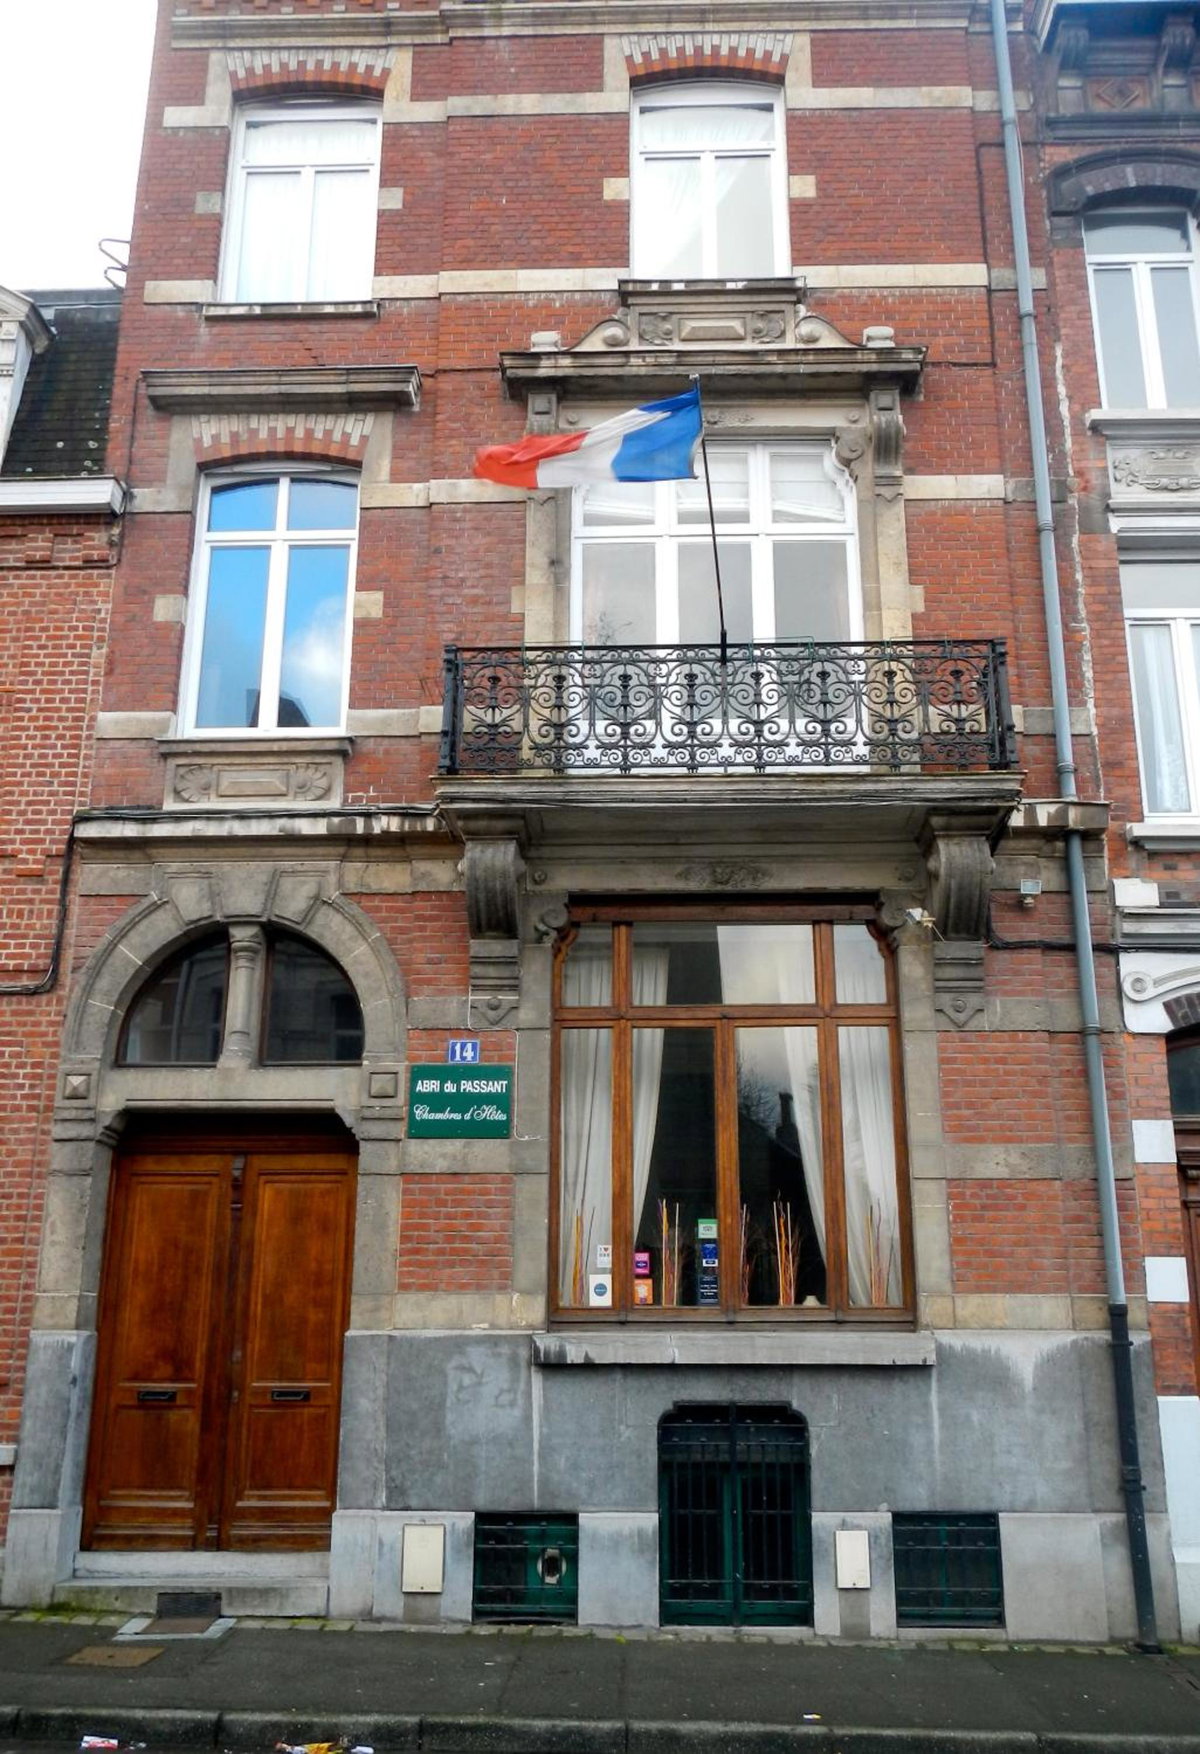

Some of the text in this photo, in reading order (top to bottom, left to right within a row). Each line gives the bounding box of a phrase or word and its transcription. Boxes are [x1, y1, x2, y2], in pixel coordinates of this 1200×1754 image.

[454, 1042, 474, 1061] 14
[416, 1080, 508, 1093] ABRI du PASSANT
[413, 1104, 507, 1121] Chambres d'Hôtes
